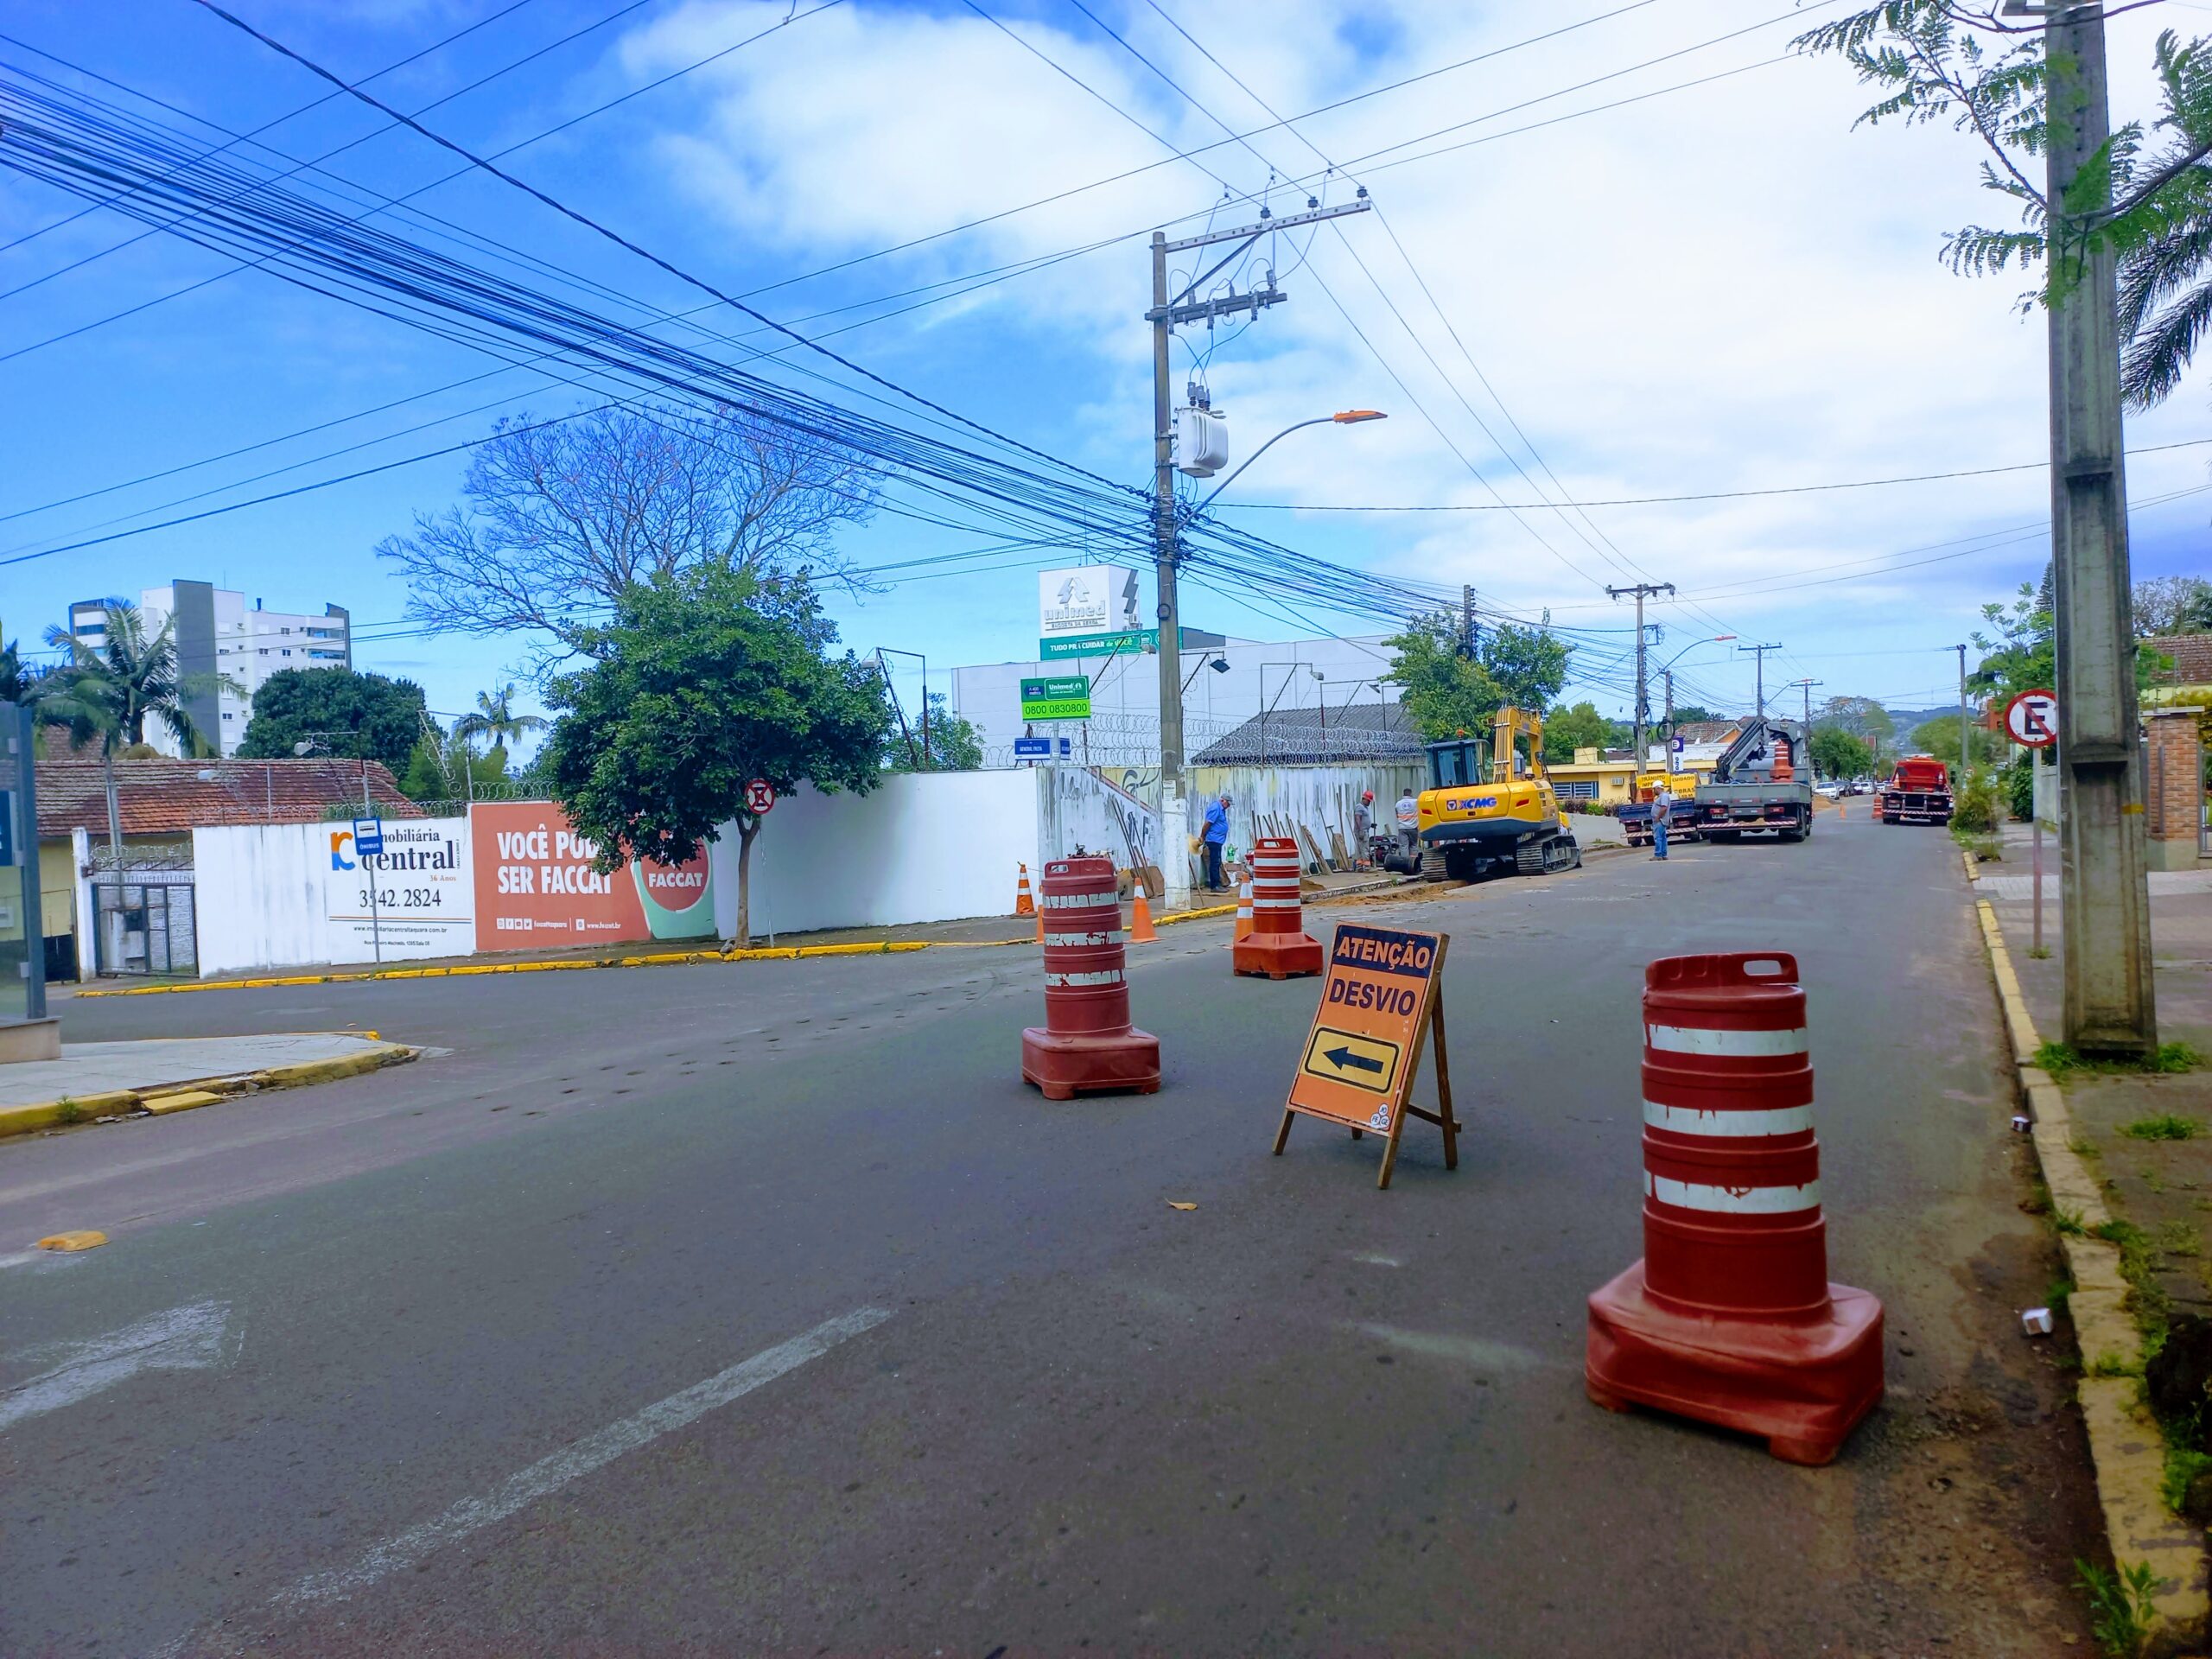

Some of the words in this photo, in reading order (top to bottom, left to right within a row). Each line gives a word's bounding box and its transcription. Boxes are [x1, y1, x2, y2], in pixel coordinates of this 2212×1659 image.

[1044, 601, 1106, 620] unimed
[1050, 644, 1068, 652] TUDO
[1082, 641, 1105, 650] CUIDAR
[1025, 705, 1047, 715] 0800
[1049, 702, 1088, 714] 0830800
[1459, 797, 1497, 810] XCMG
[497, 823, 549, 860] VOCÊ
[555, 831, 601, 860] POD
[497, 865, 535, 894] SER
[648, 872, 703, 887] FACCAT
[1336, 936, 1431, 970] ATENÇÃO
[1328, 977, 1416, 1016] DESVIO
